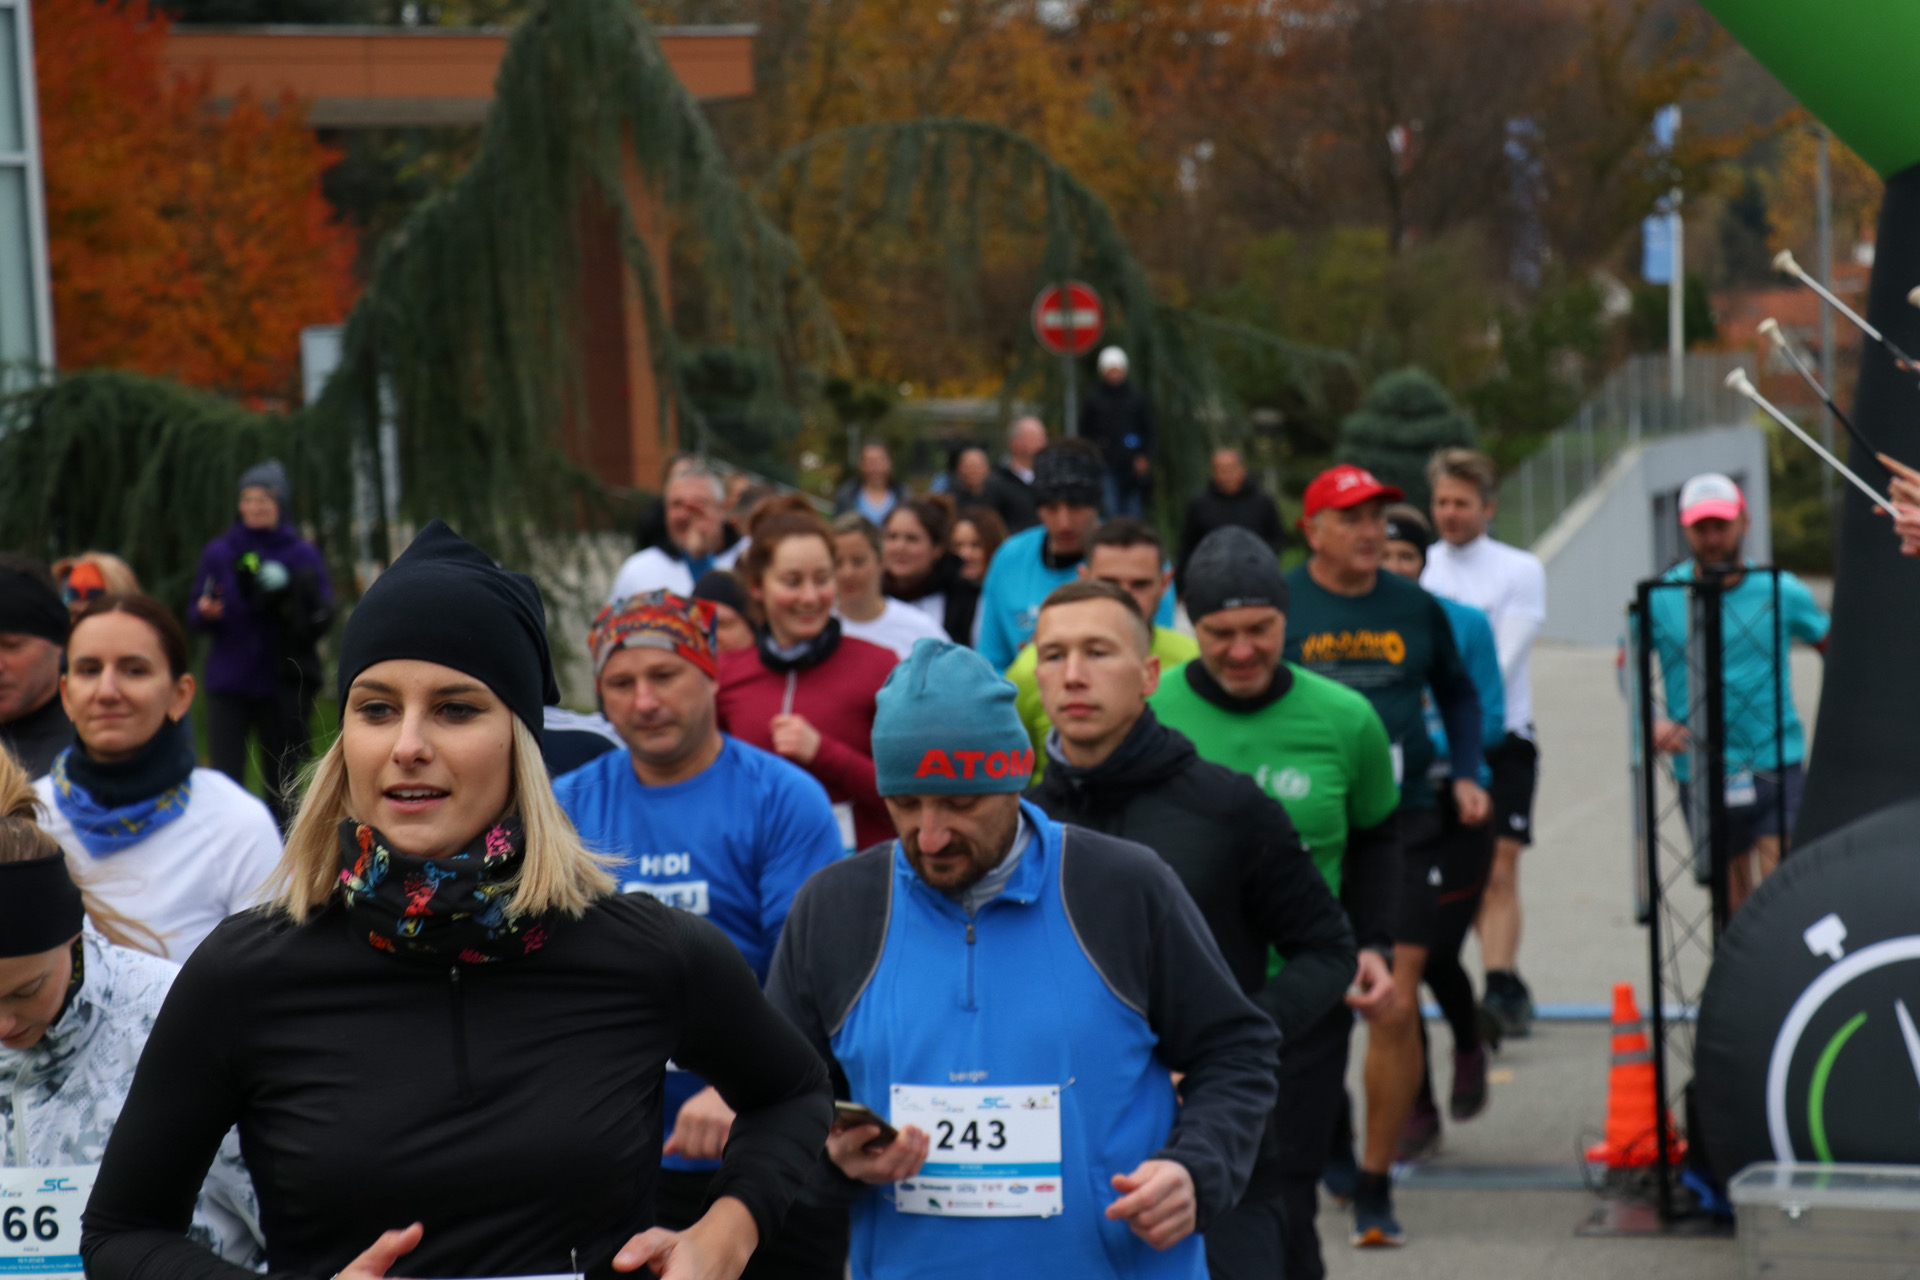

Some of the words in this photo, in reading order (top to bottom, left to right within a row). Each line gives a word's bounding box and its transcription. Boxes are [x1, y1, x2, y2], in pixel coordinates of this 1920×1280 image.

[914, 748, 1035, 779] ATOM
[640, 852, 690, 876] HDI
[936, 1120, 1007, 1150] 243
[2, 1205, 59, 1243] 66
